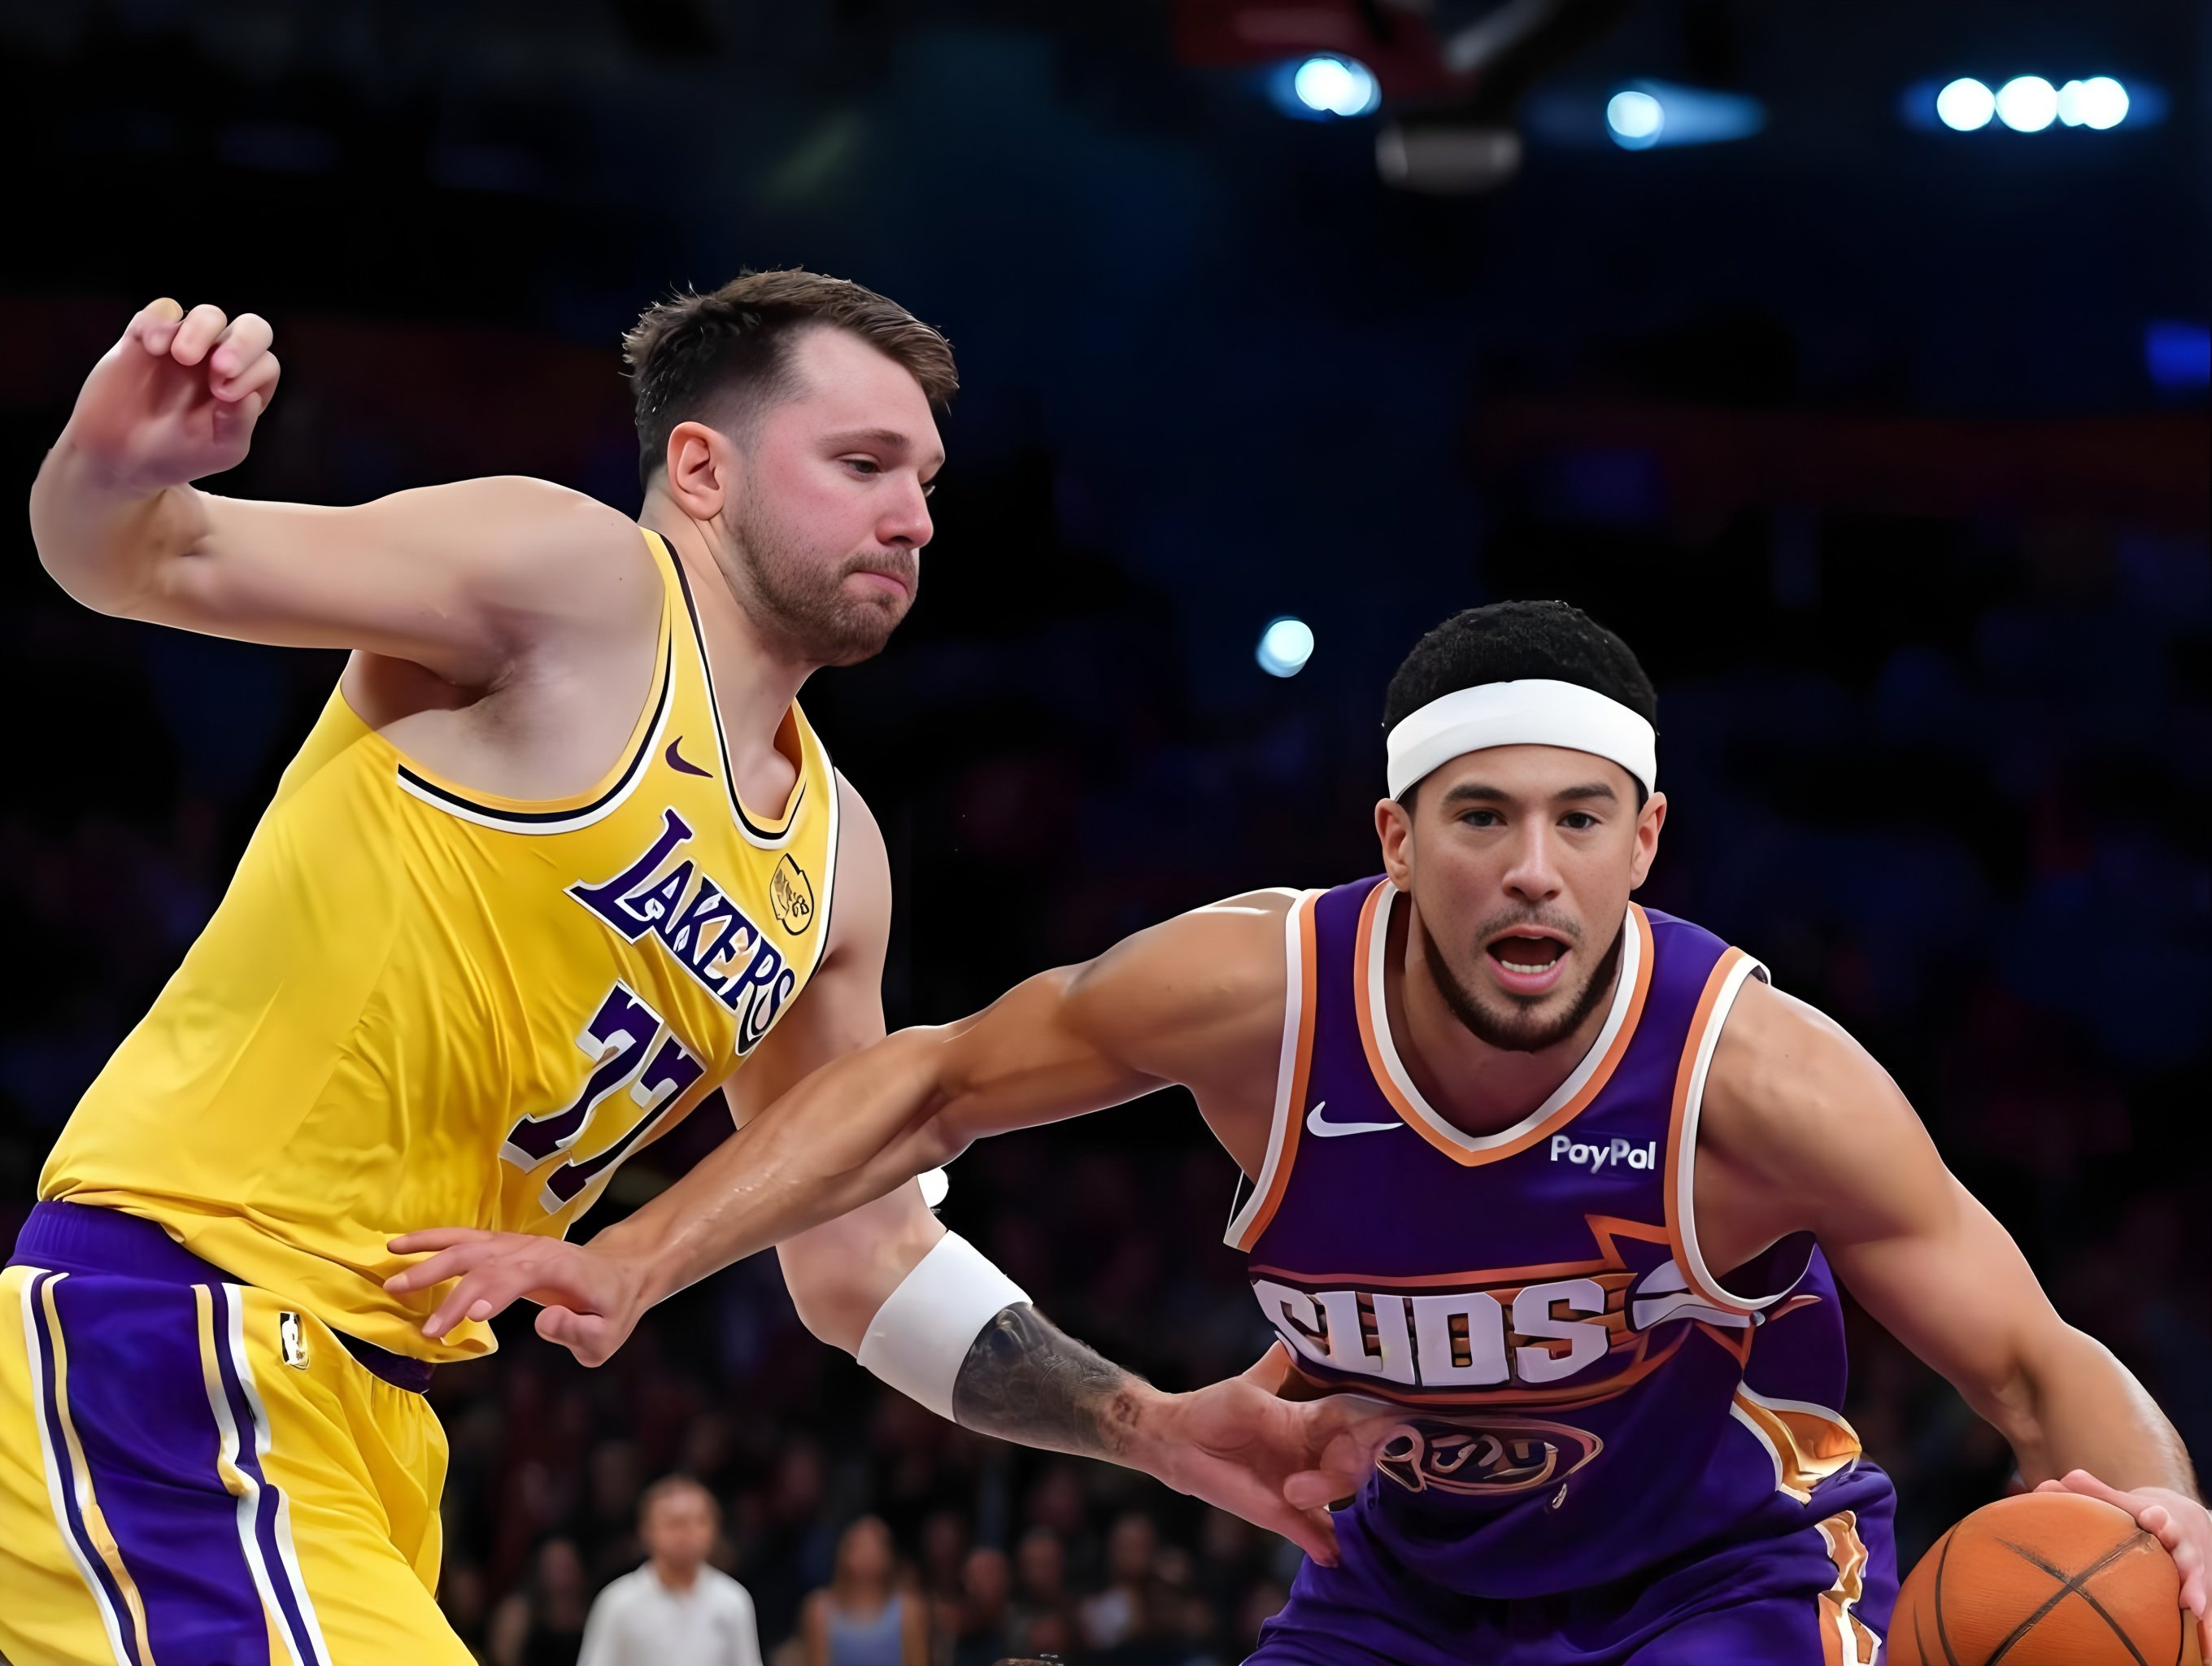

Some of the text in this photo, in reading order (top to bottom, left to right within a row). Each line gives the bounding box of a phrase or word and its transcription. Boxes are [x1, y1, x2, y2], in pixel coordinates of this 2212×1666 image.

[563, 805, 795, 1055] LAKERS
[499, 977, 707, 1215] 77
[1550, 1135, 1657, 1174] PayPal
